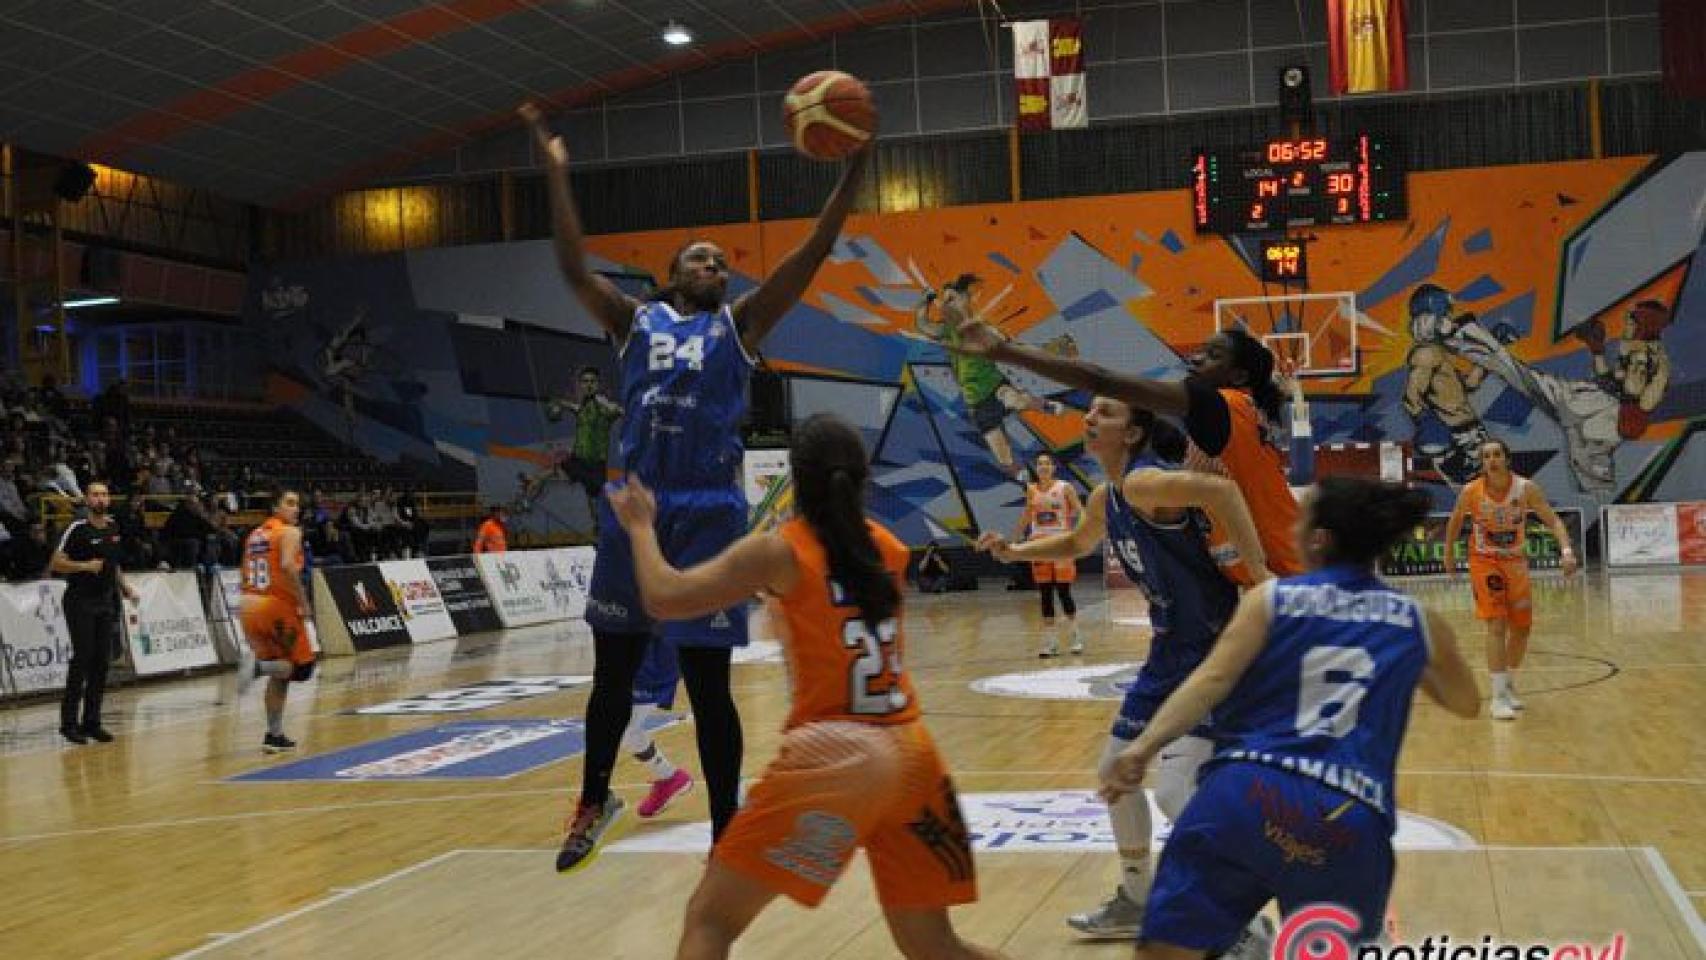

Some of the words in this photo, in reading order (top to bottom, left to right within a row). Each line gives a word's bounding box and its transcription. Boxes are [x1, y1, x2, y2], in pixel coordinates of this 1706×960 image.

[1268, 141, 1327, 163] 06:52
[1259, 180, 1278, 197] 14
[1327, 173, 1353, 193] 30
[1277, 261, 1297, 275] 14
[649, 333, 705, 371] 24
[1295, 646, 1375, 738] 6
